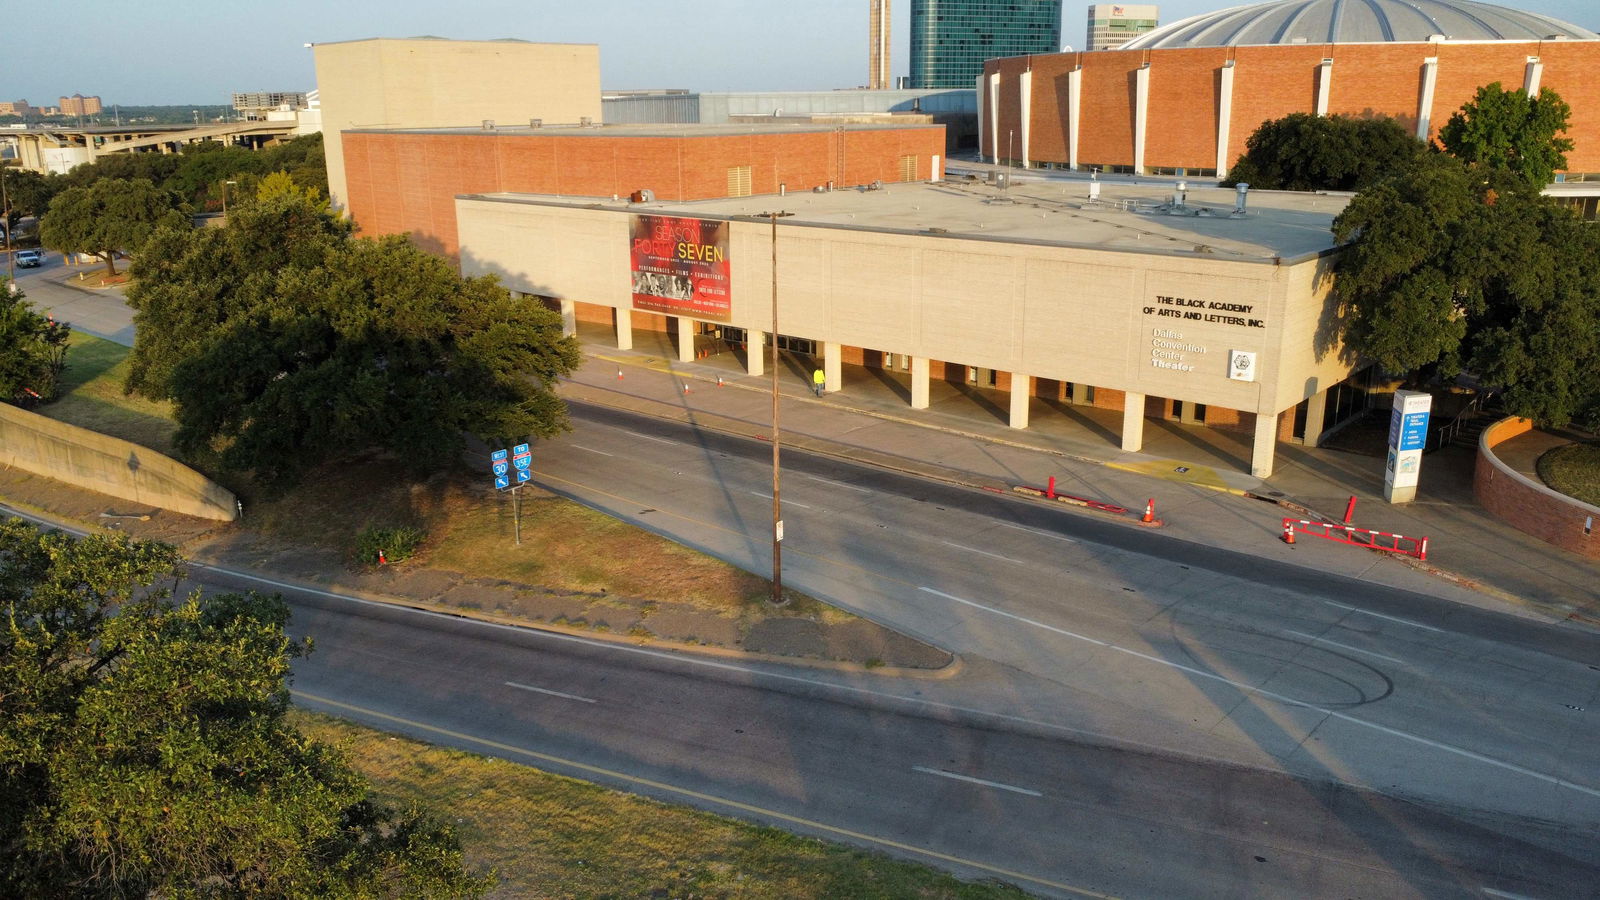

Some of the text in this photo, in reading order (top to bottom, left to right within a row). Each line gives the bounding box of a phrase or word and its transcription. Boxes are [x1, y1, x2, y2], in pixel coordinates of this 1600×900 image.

[655, 225, 700, 244] SEASON
[633, 238, 723, 263] FORTY SEVEN
[1156, 295, 1253, 314] THE BLACK ACADEMY
[1143, 306, 1266, 329] OF ARTS AND LETTERS, INC.
[1152, 328, 1183, 340] Dallas
[1152, 338, 1207, 354] Convention
[1151, 348, 1184, 361] Center
[1151, 358, 1195, 372] Theater
[495, 464, 506, 475] 30
